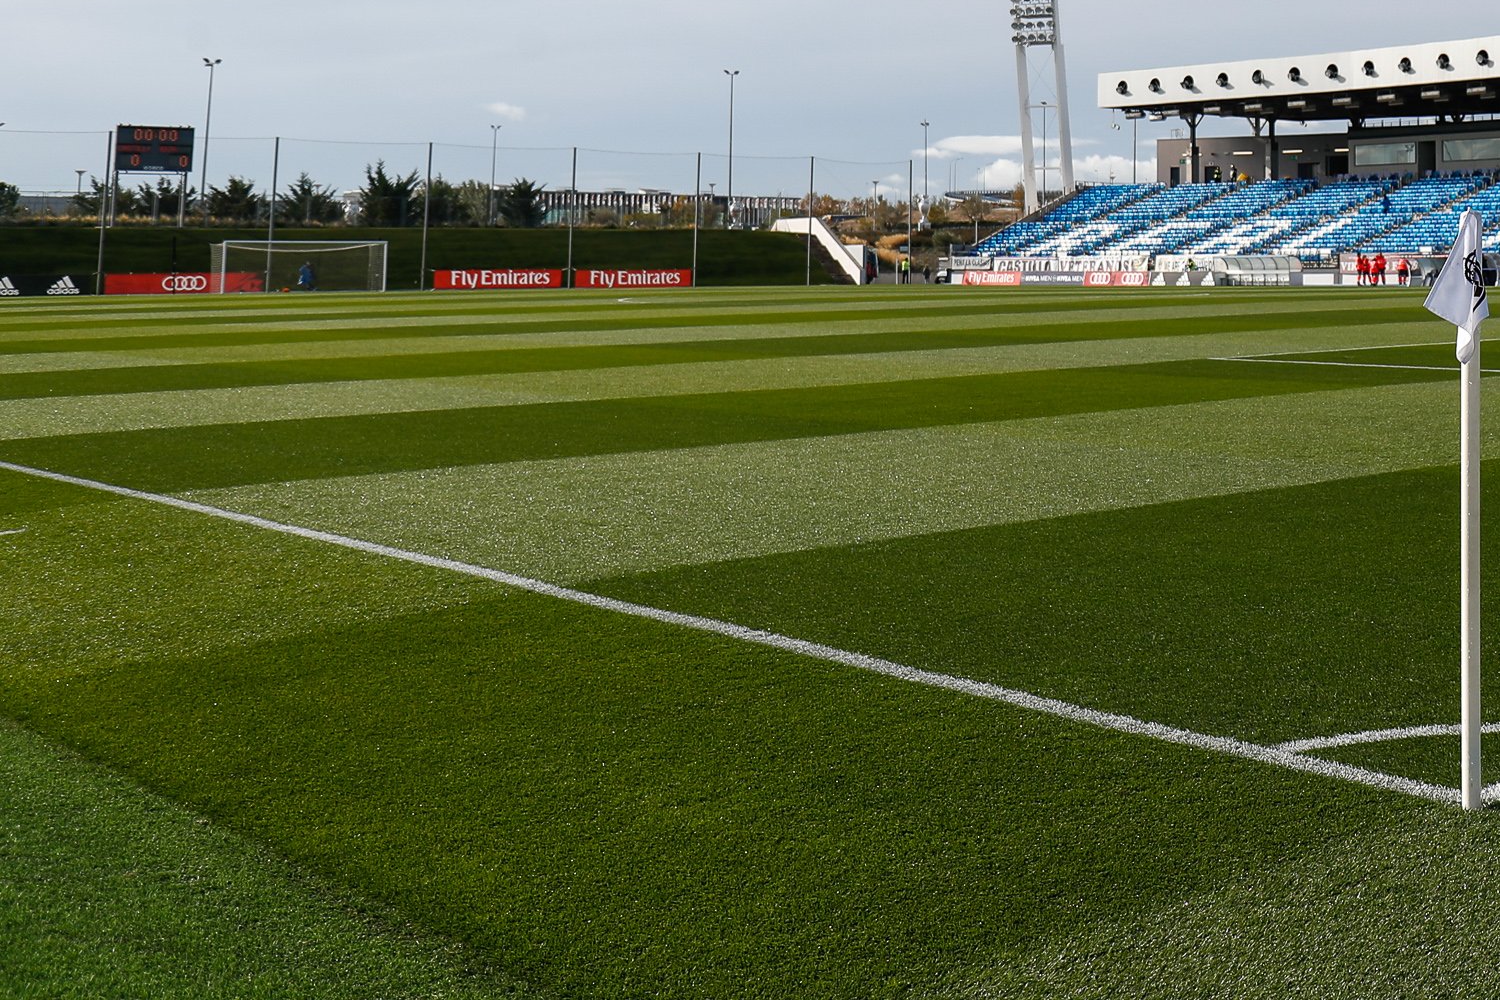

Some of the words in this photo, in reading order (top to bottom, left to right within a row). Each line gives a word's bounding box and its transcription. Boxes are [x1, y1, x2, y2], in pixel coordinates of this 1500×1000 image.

[130, 153, 140, 167] 0
[179, 155, 189, 167] 0
[450, 270, 478, 290] Fly
[481, 270, 550, 286] Emirates
[590, 270, 615, 288] Fly
[618, 269, 681, 285] Emirates
[969, 272, 982, 285] Fly
[982, 271, 1015, 283] Emirates
